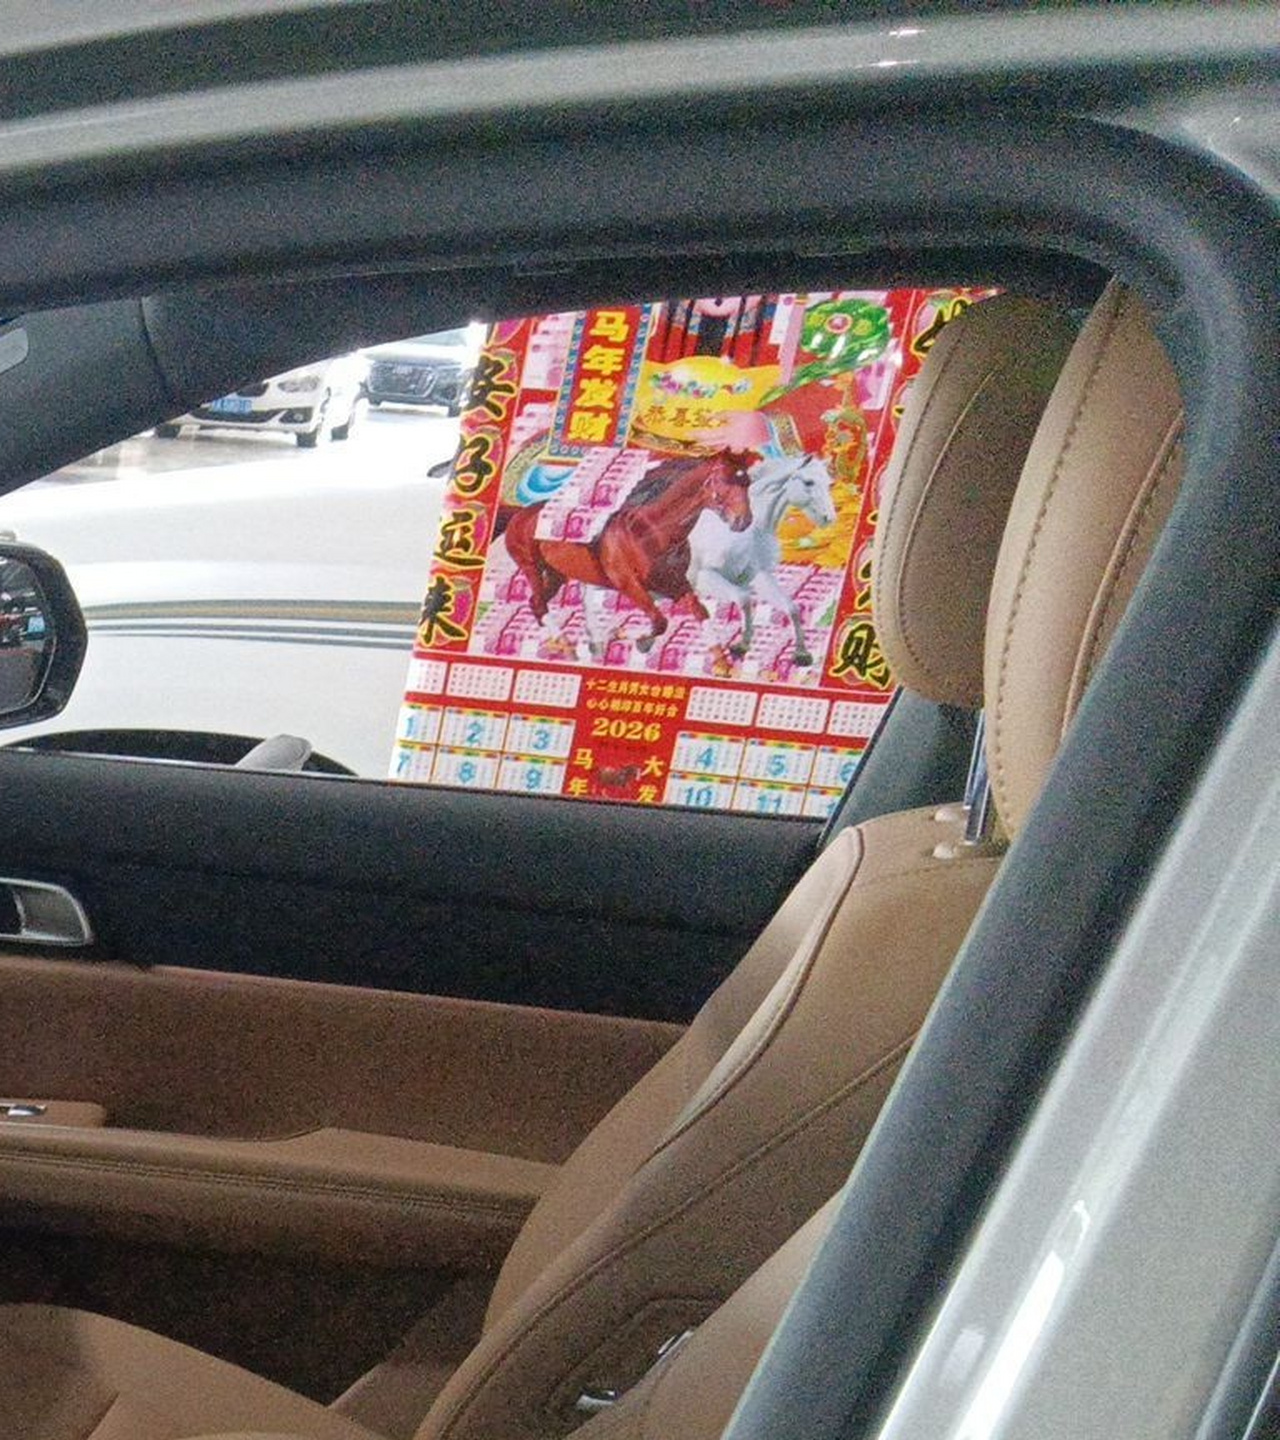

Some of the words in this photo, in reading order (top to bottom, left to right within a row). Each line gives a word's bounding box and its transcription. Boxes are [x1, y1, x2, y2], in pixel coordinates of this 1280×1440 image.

[567, 311, 629, 443] 马年发财
[415, 322, 515, 647] 安好运来
[466, 721, 483, 745] 2
[532, 729, 551, 750] 3
[696, 747, 715, 769] 4
[767, 754, 787, 777] 5
[592, 717, 662, 742] 2026
[397, 751, 411, 774] 7
[458, 760, 475, 783] 8
[525, 767, 543, 790] 9
[684, 786, 713, 808] 10
